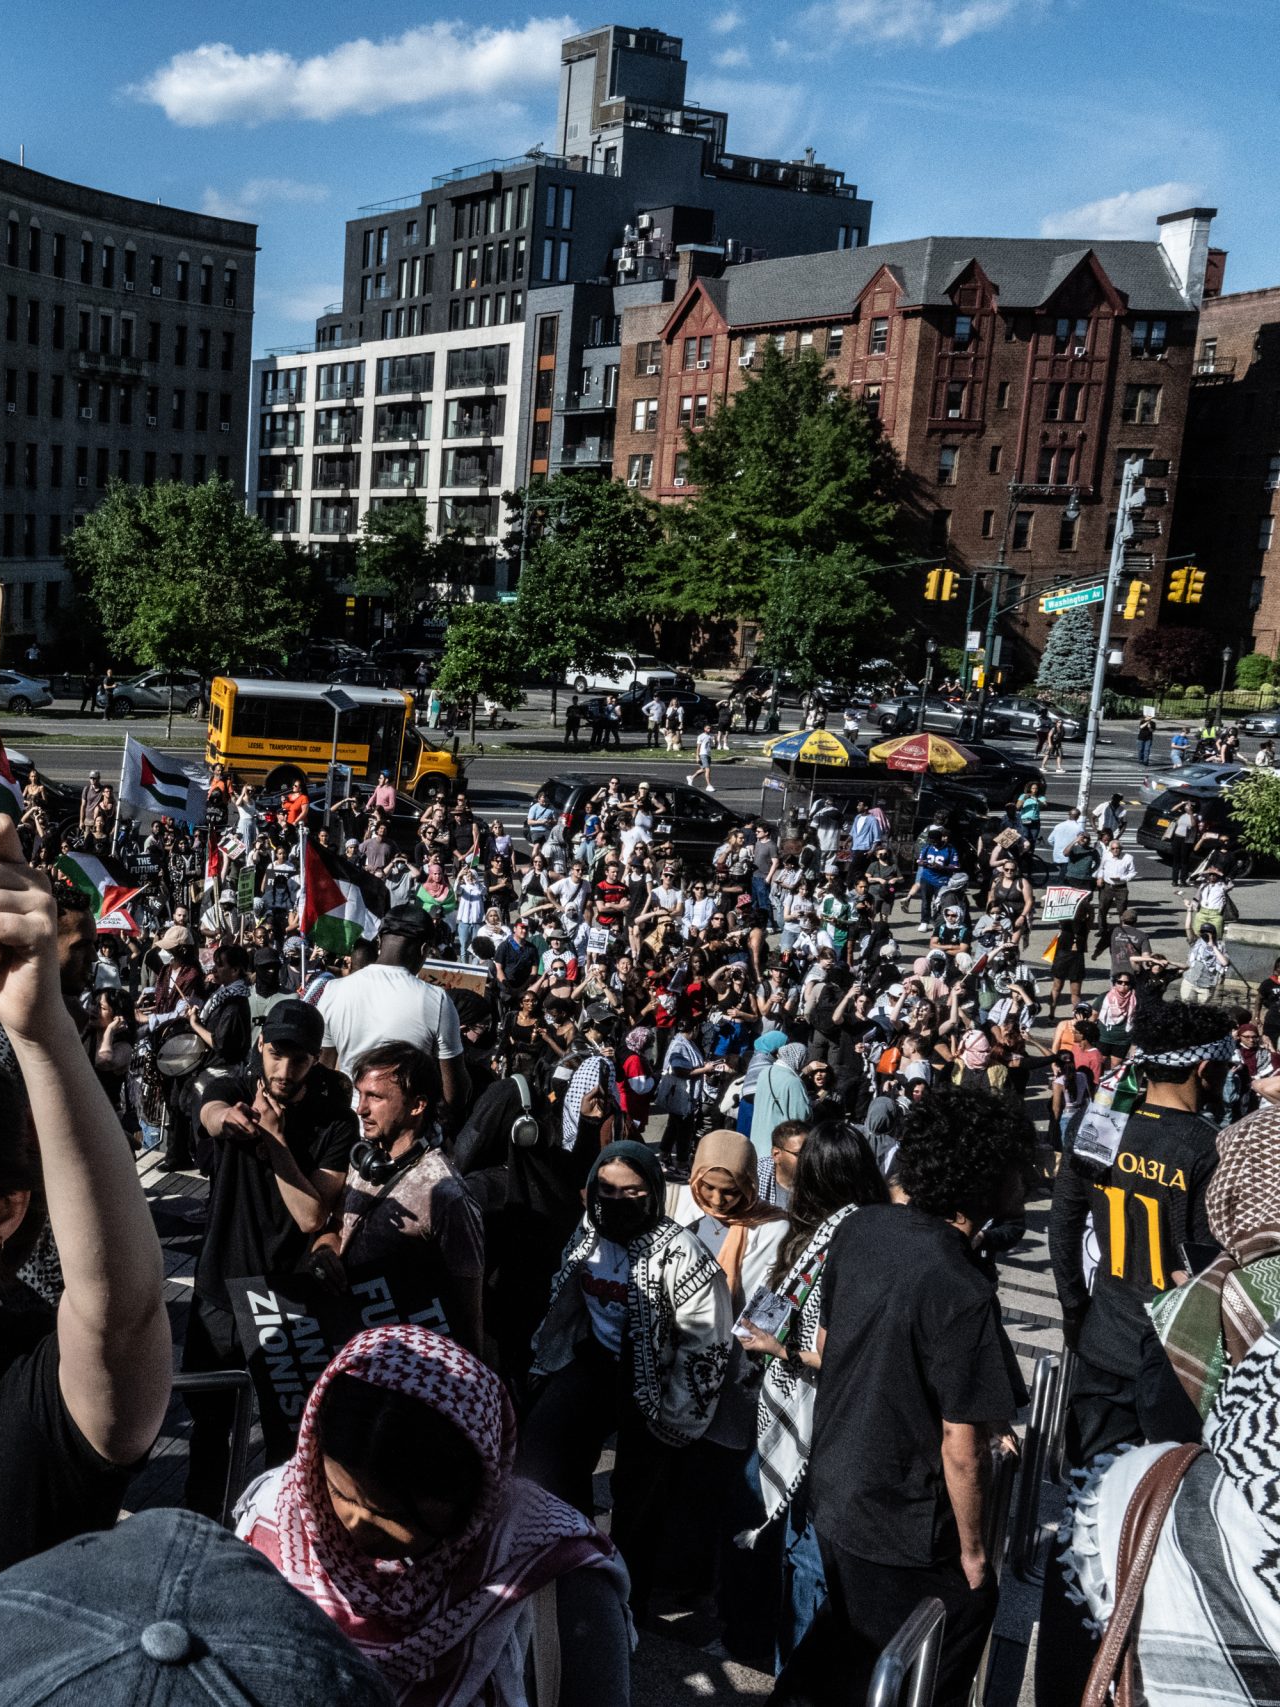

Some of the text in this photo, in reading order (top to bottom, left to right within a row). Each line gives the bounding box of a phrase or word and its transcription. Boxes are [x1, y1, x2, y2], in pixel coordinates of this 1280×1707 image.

[1048, 590, 1101, 608] Washington Av
[269, 743, 307, 752] TRANSPORTATION
[136, 857, 151, 865] THE
[130, 865, 159, 873] FUTURE
[1104, 1186, 1165, 1291] 11
